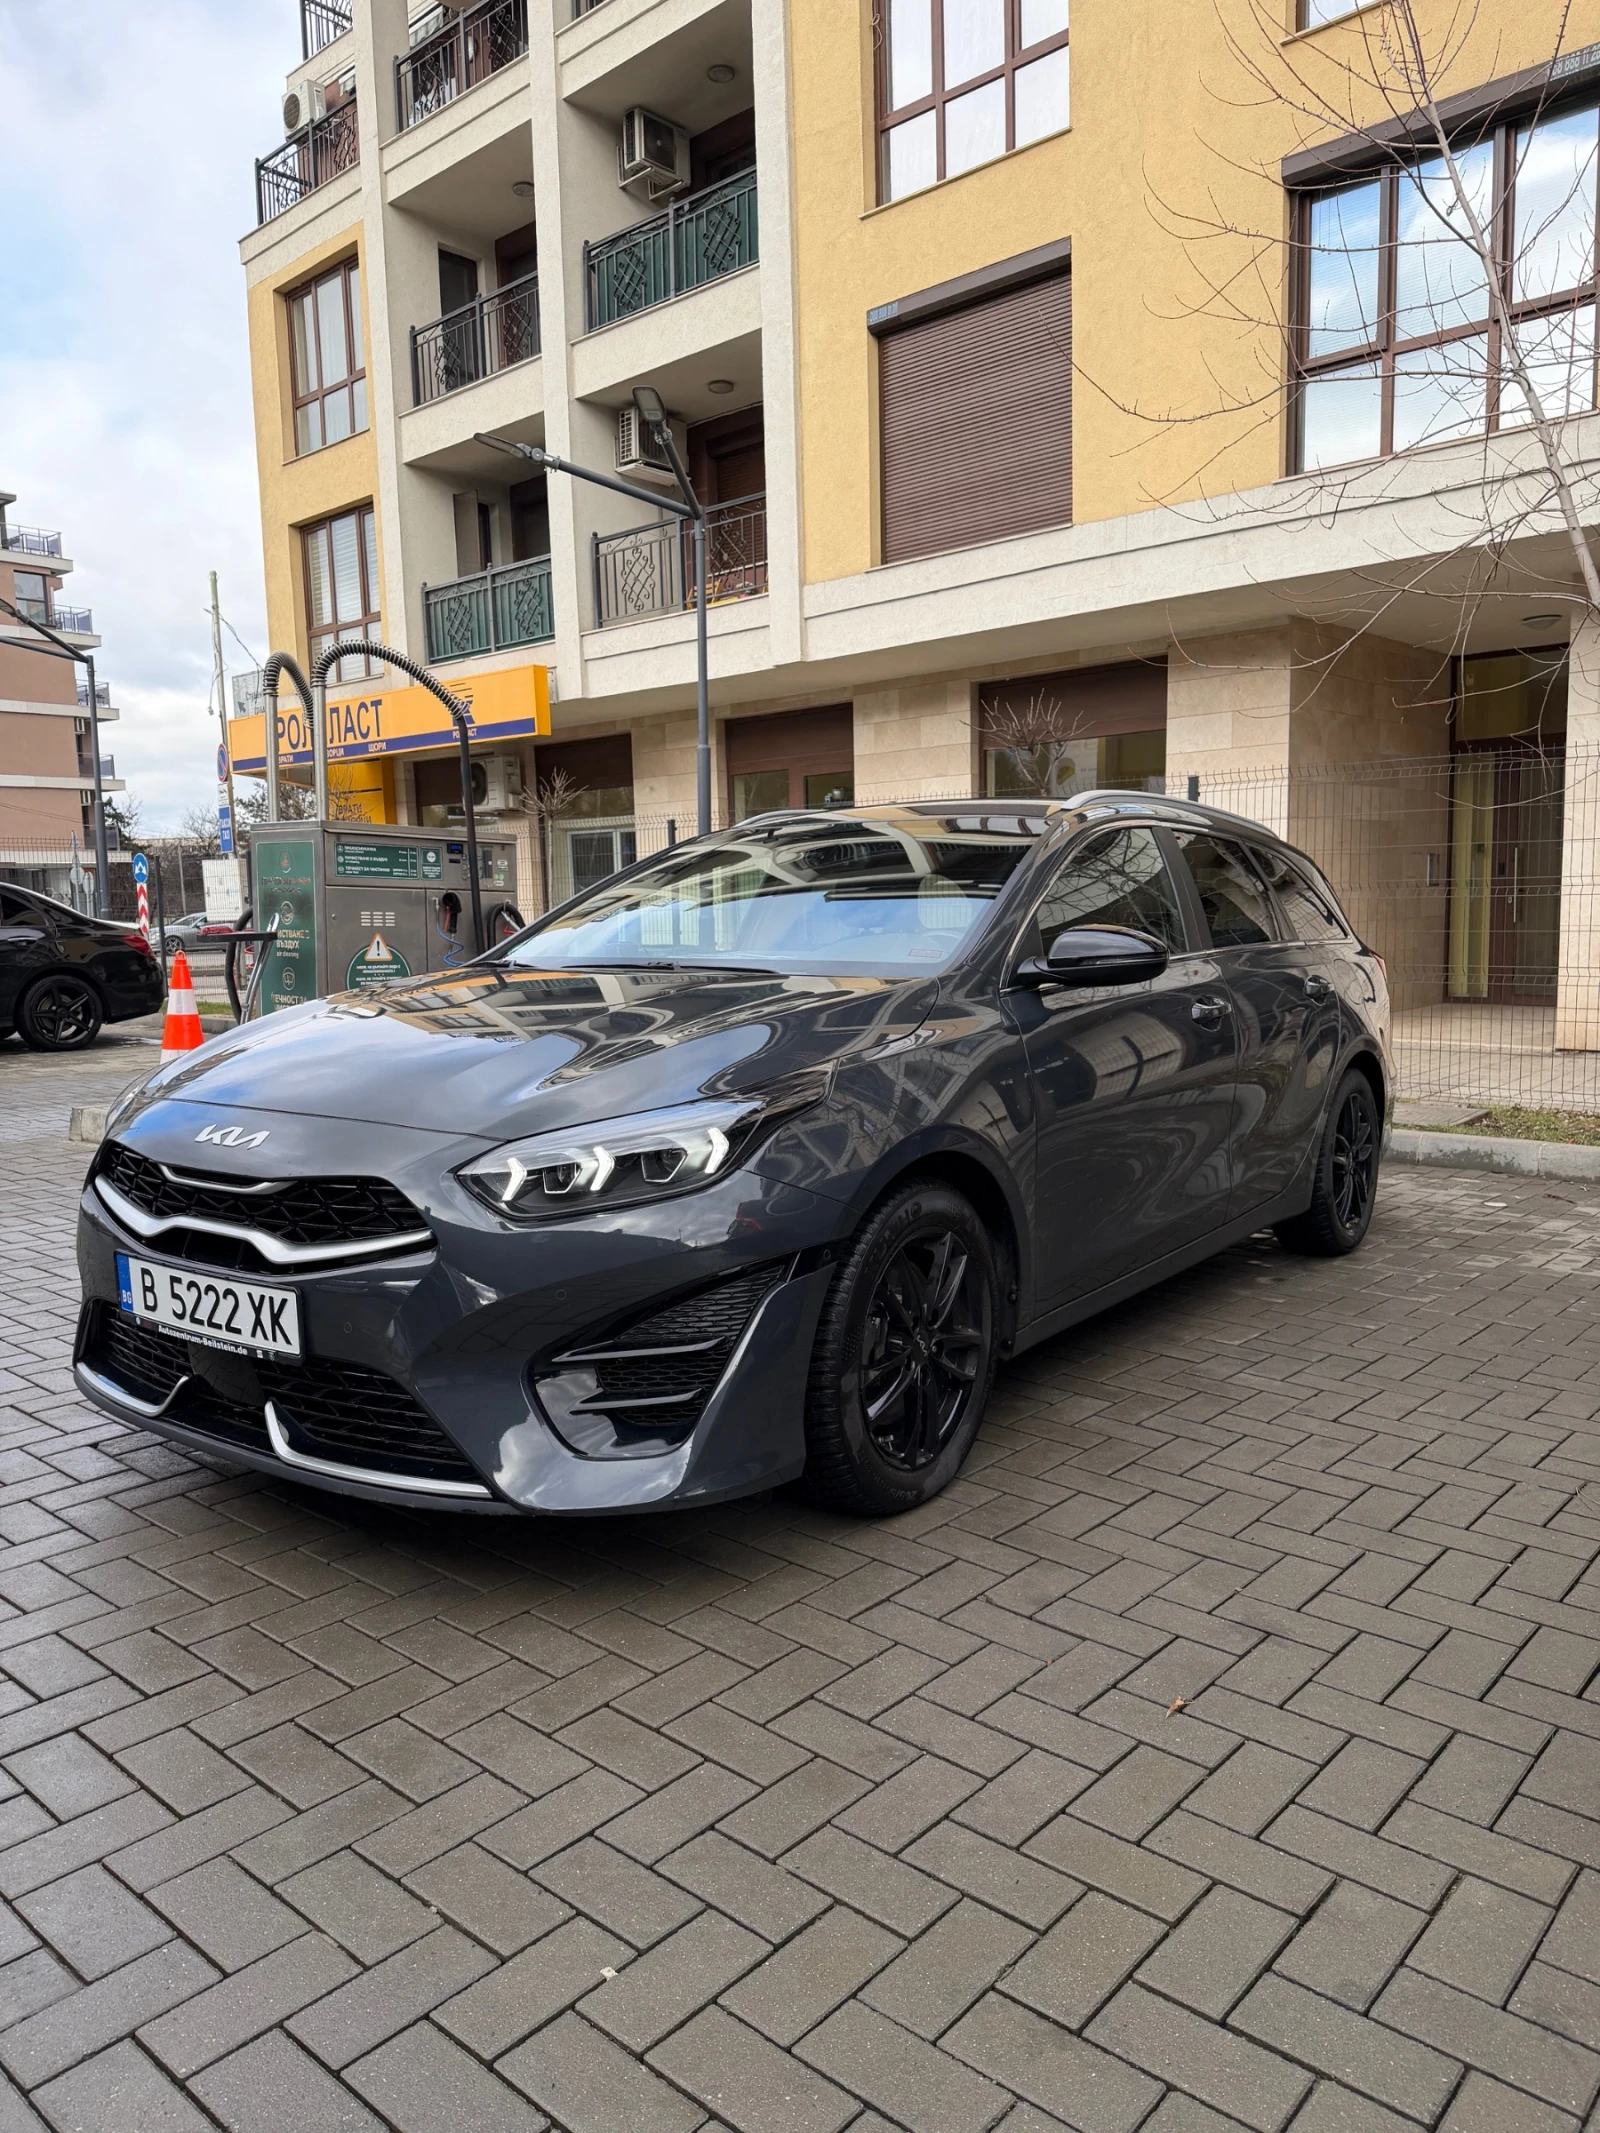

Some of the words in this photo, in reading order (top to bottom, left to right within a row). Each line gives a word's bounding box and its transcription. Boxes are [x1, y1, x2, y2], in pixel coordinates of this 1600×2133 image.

[277, 700, 383, 750] РОЛЛАСТ
[452, 728, 477, 739] РОАСТ
[368, 742, 387, 752] ЩОРИ
[277, 930, 304, 938] ИСТВАНЕ
[276, 940, 299, 950] ВЪЗДУХ
[194, 1123, 270, 1150] KIA
[122, 1289, 132, 1304] BG
[140, 1267, 158, 1312] B
[169, 1274, 242, 1335] 5222
[247, 1291, 293, 1345] XK
[158, 1324, 248, 1356] Autozentrum-Beilstein.de
